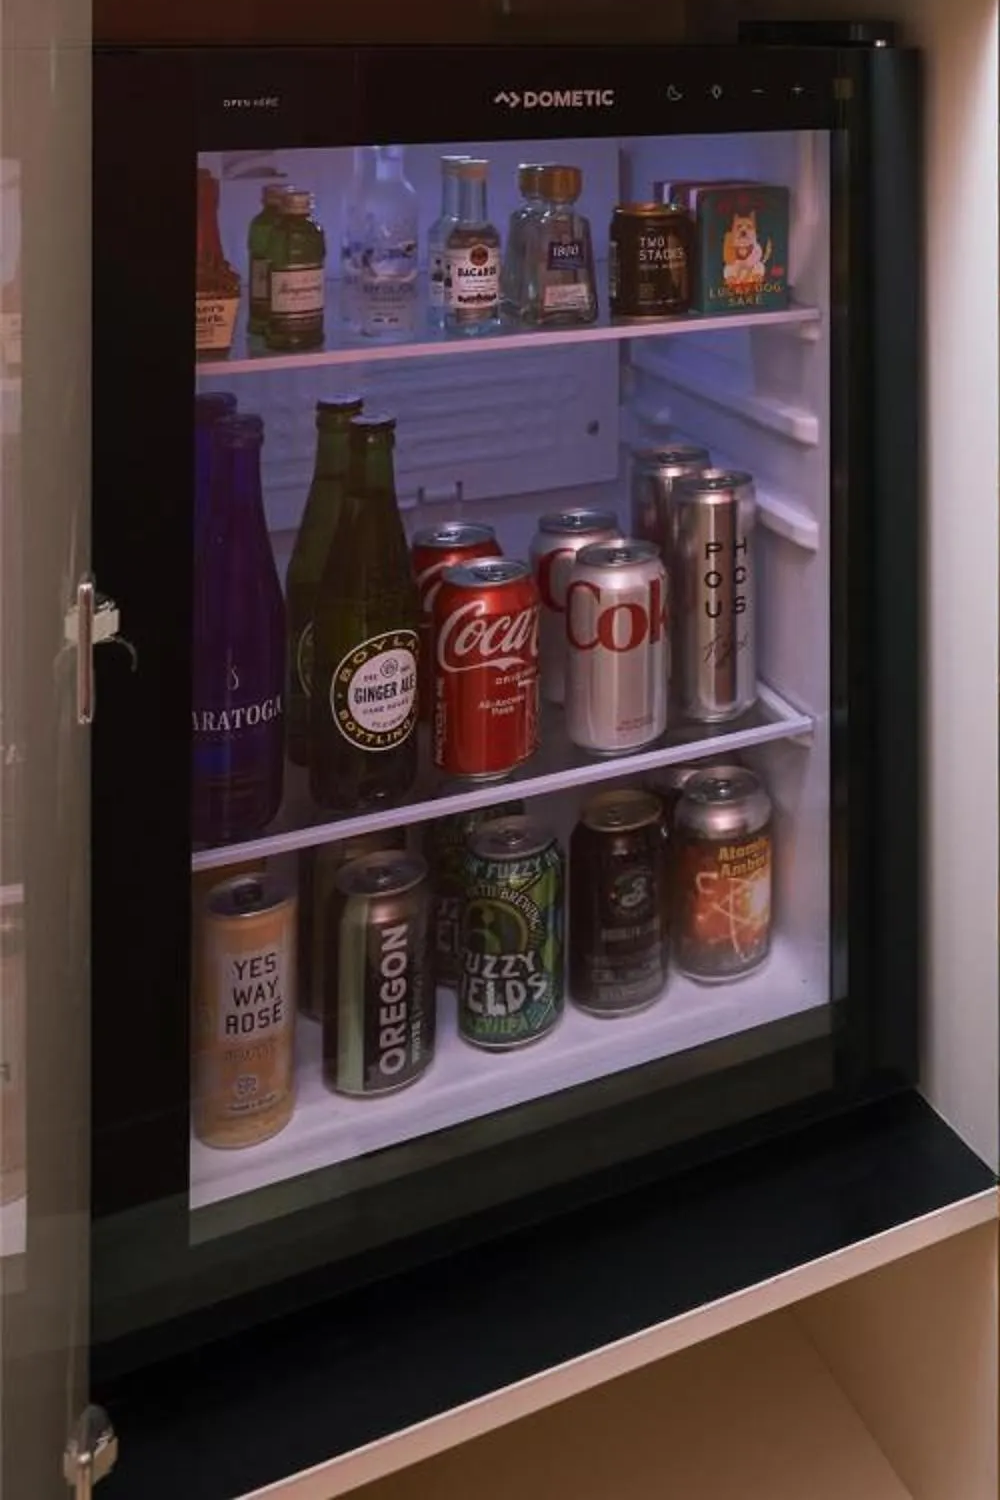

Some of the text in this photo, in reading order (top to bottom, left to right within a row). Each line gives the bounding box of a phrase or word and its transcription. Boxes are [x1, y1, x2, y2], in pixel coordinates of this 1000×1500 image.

[523, 89, 615, 108] DOMETIC
[639, 235, 666, 248] TWO
[354, 672, 417, 705] GINGER ALE
[192, 694, 282, 732] ARATOGA
[485, 856, 541, 880] FUZZY
[233, 952, 278, 981] YES
[463, 949, 536, 979] UZZY
[233, 976, 279, 1008] WAY
[379, 921, 409, 1076] OREGON
